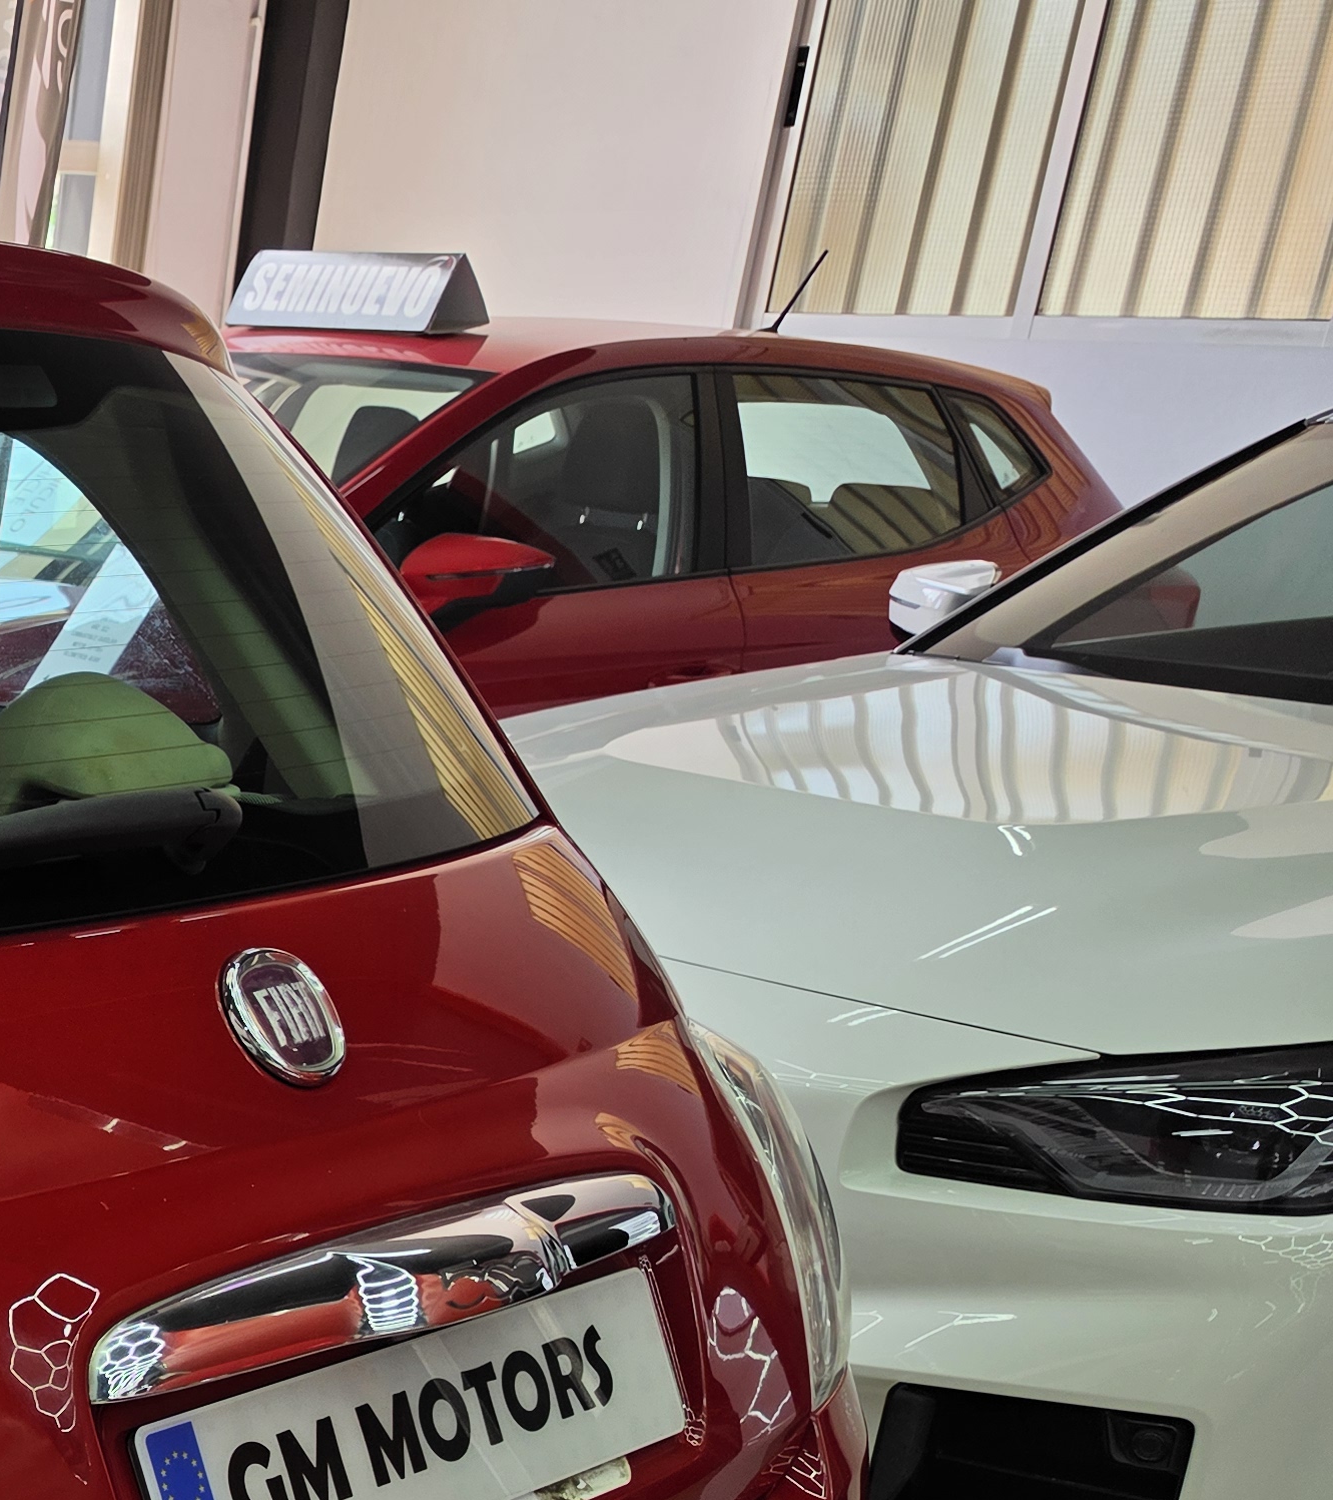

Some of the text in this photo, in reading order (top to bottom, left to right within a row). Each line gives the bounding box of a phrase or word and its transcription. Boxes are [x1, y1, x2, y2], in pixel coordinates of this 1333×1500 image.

[243, 262, 441, 318] SEMINUEVO
[253, 981, 326, 1047] FIAT
[355, 1324, 614, 1488] MOTORS
